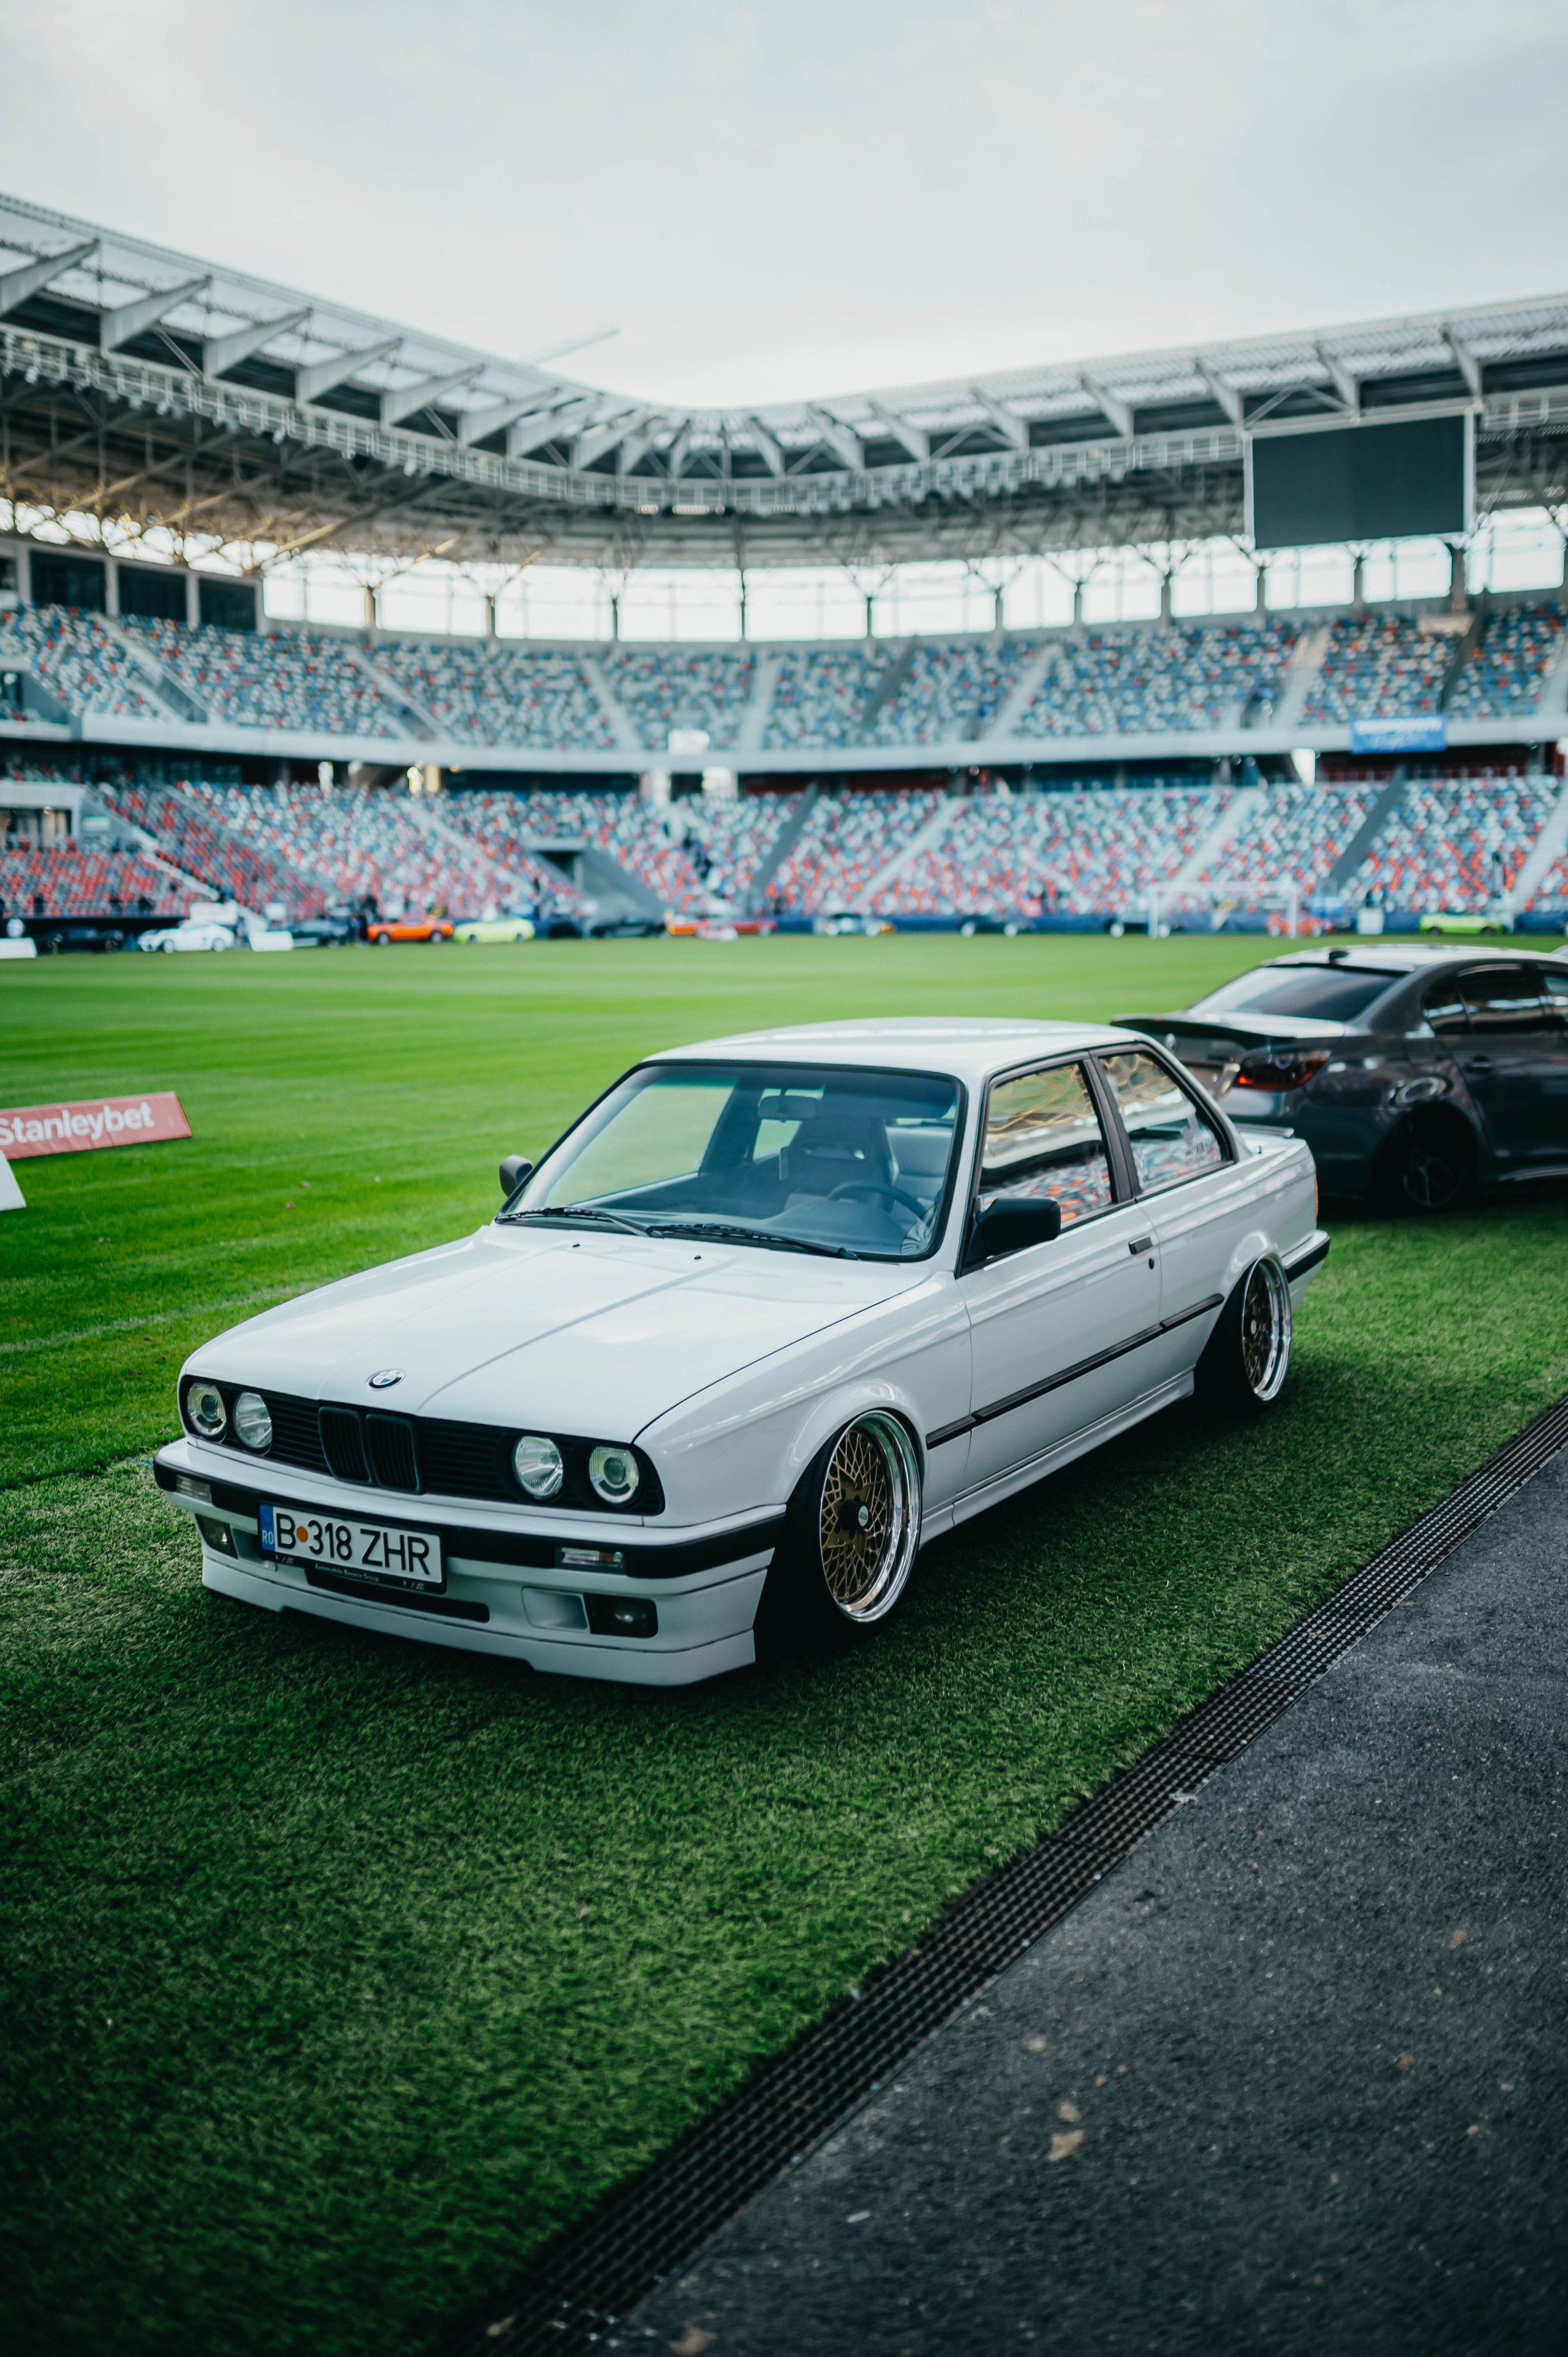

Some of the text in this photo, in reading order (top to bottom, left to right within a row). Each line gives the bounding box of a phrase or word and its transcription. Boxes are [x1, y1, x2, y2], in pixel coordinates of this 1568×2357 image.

[0, 1102, 154, 1146] Stanleybet
[262, 1529, 274, 1545] RO
[276, 1512, 430, 1575] B 318 ZHR
[315, 1564, 342, 1574] Automobile
[363, 1574, 379, 1582] Group
